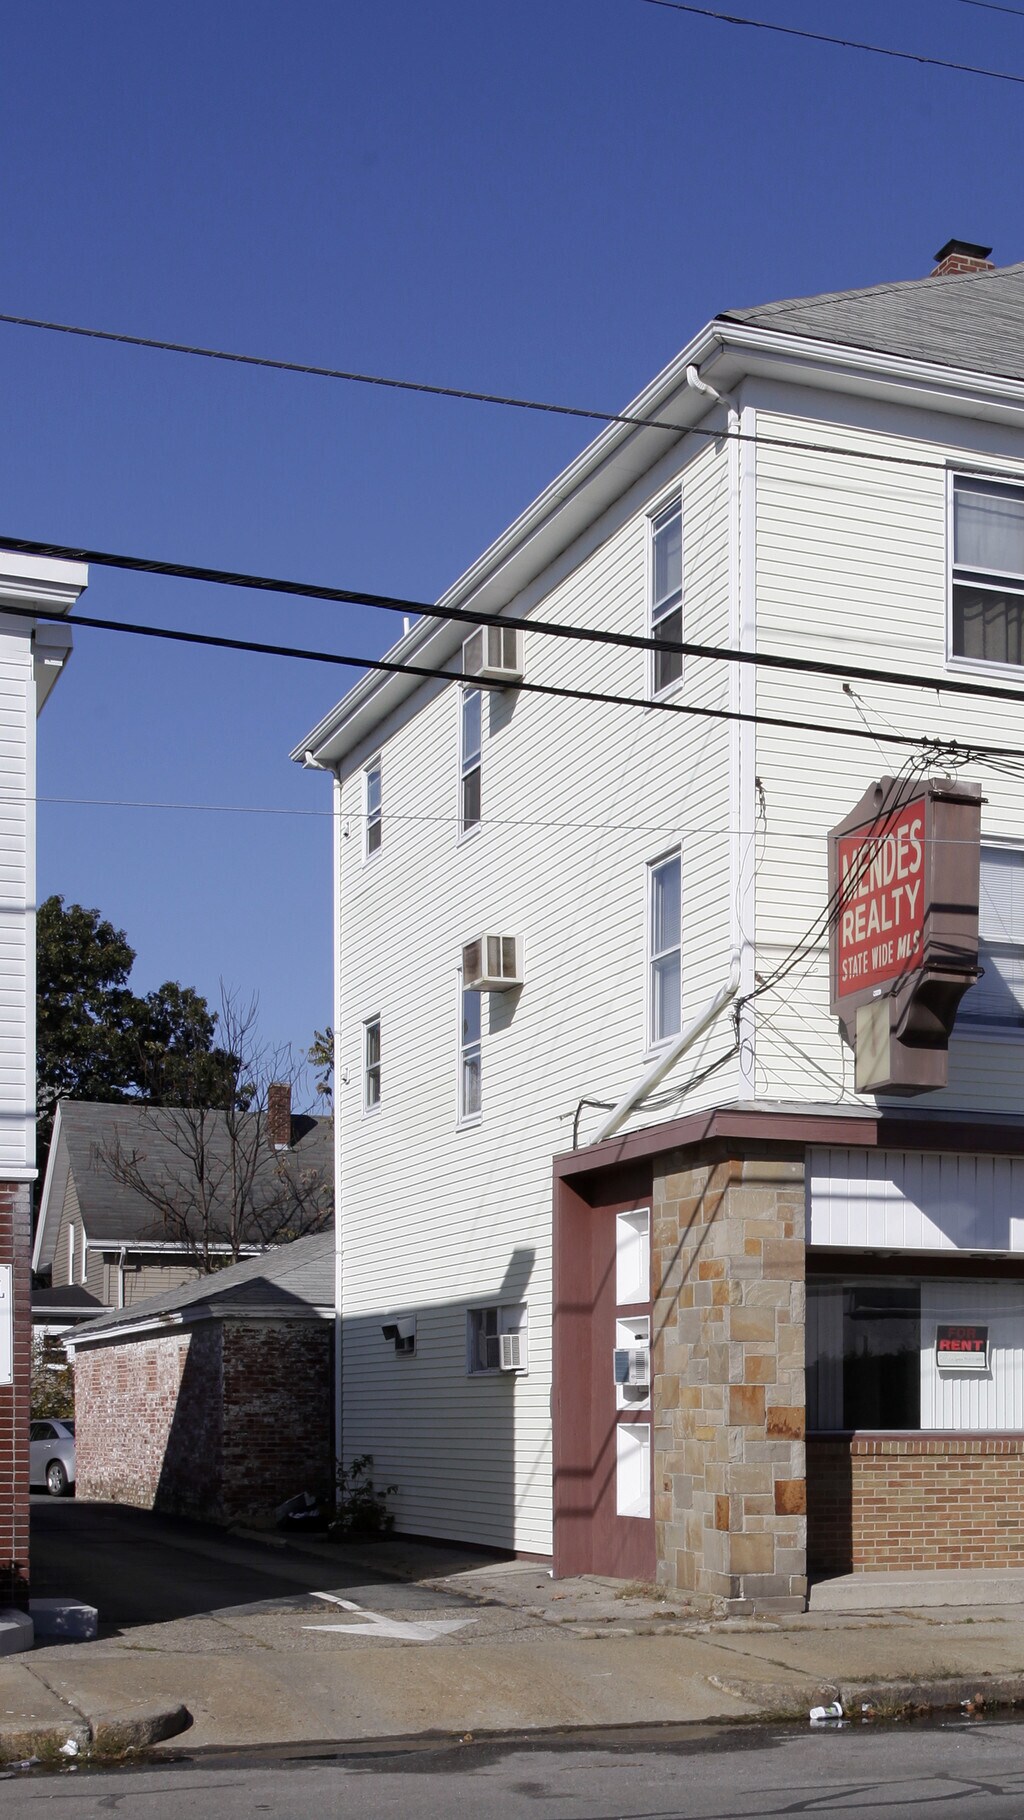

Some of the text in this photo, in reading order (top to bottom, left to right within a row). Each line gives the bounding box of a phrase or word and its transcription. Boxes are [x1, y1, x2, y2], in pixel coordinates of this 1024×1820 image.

[842, 819, 922, 902] MENDES
[842, 879, 921, 948] REALTY
[842, 930, 920, 982] STATE WIDE MLS
[940, 1339, 983, 1351] RENT
[948, 1327, 977, 1339] FOR
